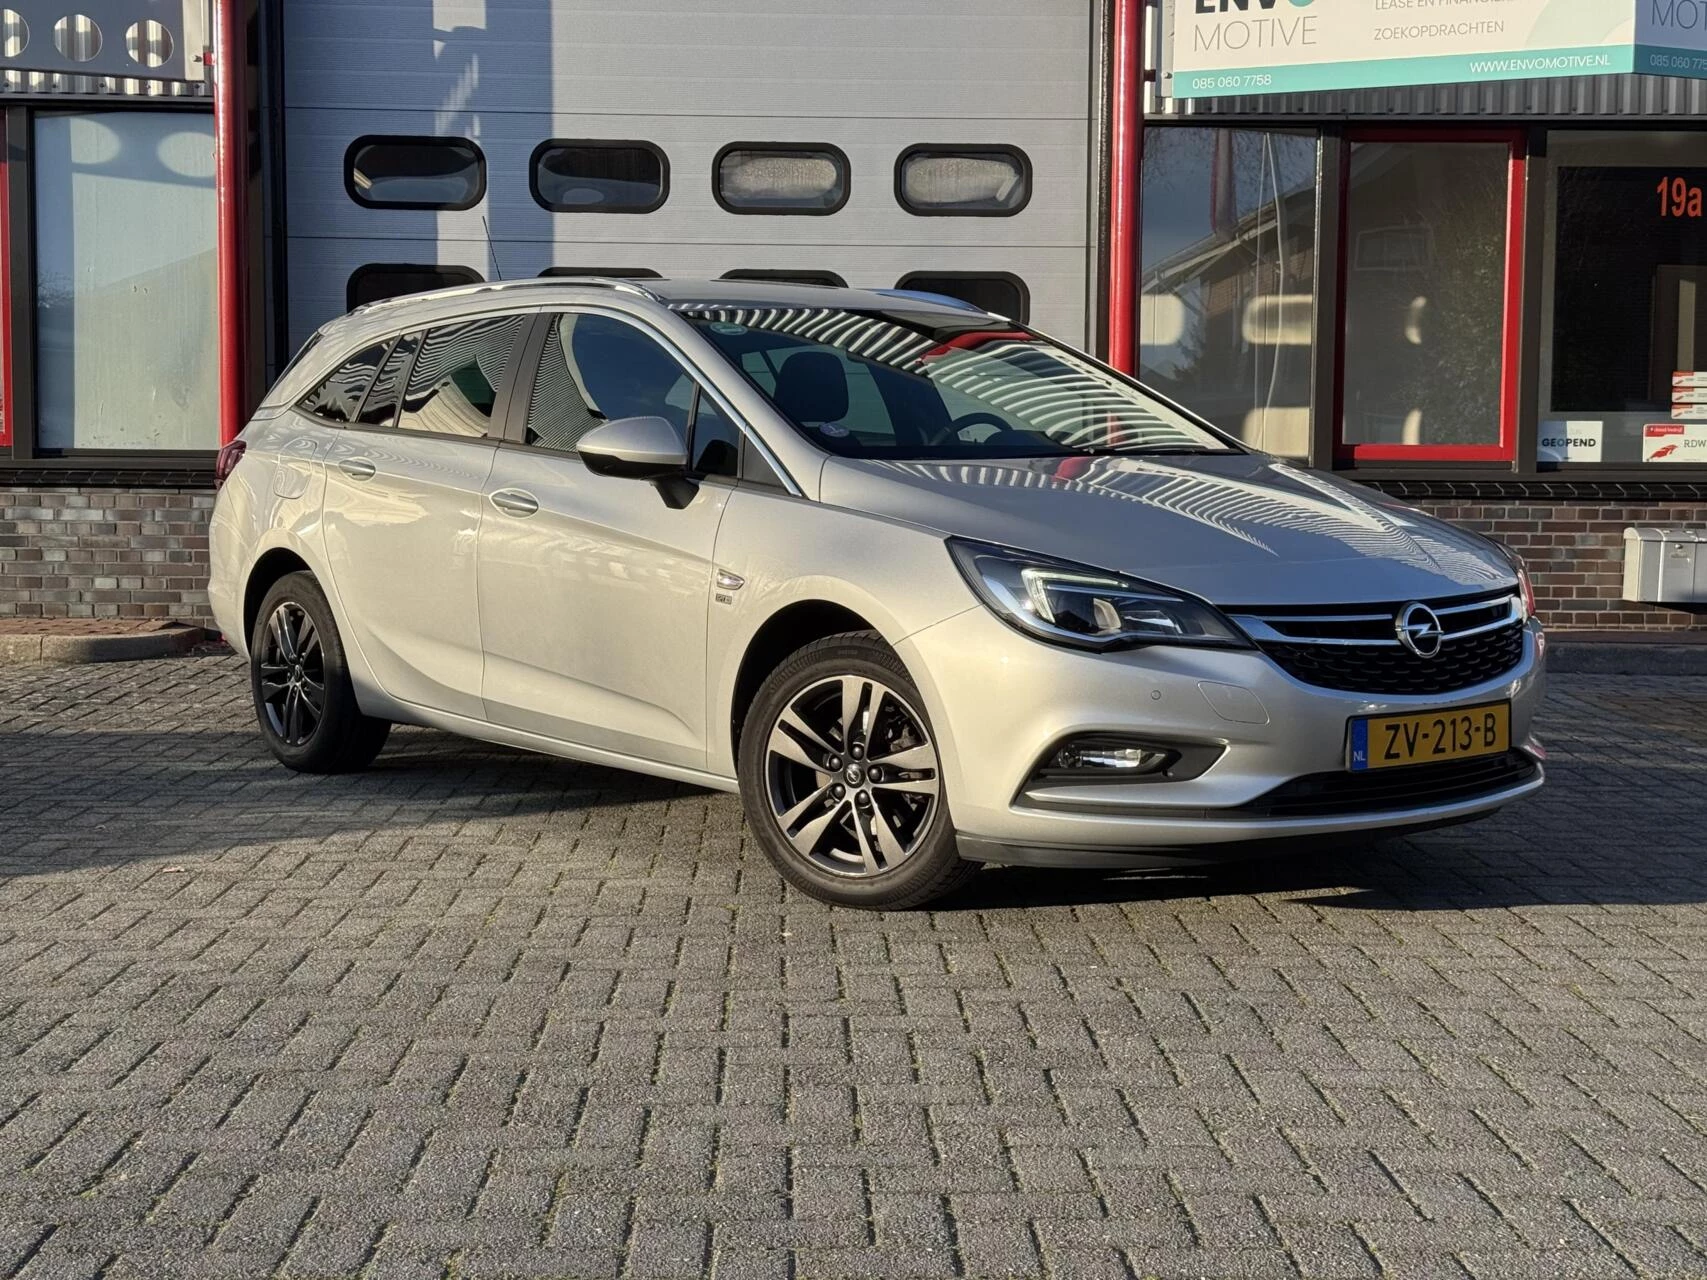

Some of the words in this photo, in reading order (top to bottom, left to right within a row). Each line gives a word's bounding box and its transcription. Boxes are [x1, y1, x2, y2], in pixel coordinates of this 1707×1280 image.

[1194, 16, 1318, 52] MOTIVE
[1374, 21, 1505, 41] ZOEKOPDRACHTEN
[1469, 54, 1612, 73] WWW.ENVOMOTIVE.NL
[1649, 54, 1669, 68] 085
[1671, 56, 1690, 69] 060
[1192, 78, 1215, 90] 085
[1217, 76, 1241, 89] 060
[1243, 74, 1272, 88] 7758
[1656, 176, 1703, 217] 19a
[1541, 437, 1597, 448] GEOPEND
[1683, 439, 1707, 448] RDW
[1384, 712, 1497, 760] ZV-213-B
[1353, 751, 1367, 762] NL
